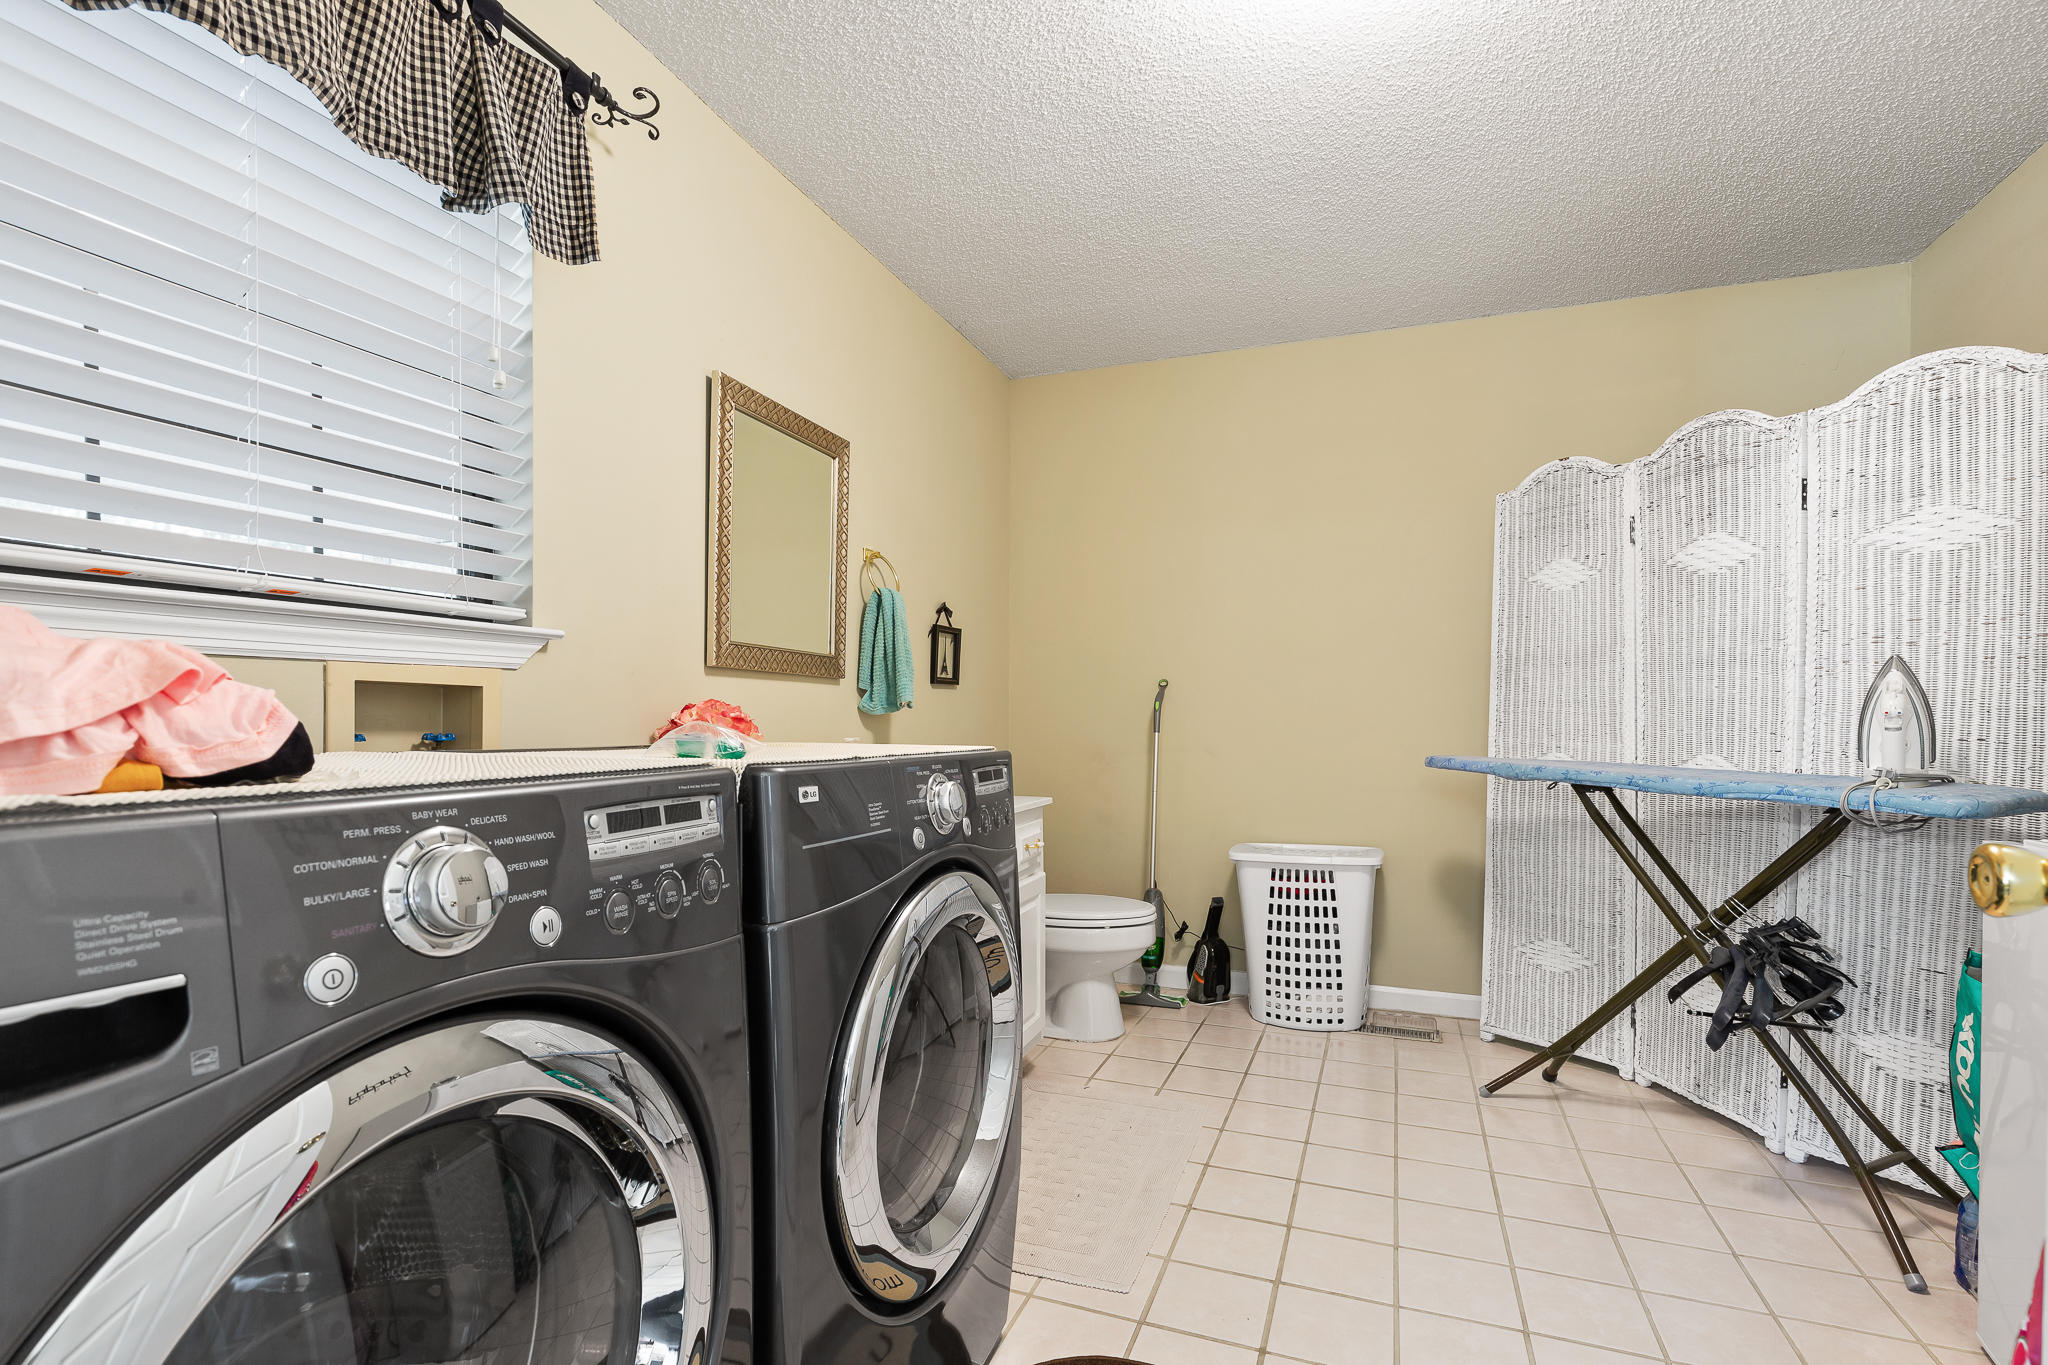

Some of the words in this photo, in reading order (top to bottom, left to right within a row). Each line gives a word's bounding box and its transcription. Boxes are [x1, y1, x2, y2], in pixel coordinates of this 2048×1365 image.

[411, 810, 434, 820] BABY
[434, 807, 459, 818] WEAR
[470, 814, 508, 826] DELICATES
[342, 828, 371, 839] PERM.
[373, 825, 402, 836] PRESS
[494, 837, 514, 847] HAND
[514, 831, 556, 844] WASH/WOOL
[292, 855, 379, 874] COTTON/NORMAL
[507, 862, 529, 872] SPEED
[529, 858, 549, 869] WASH
[303, 888, 371, 907] BULKY/LARGE
[508, 889, 547, 903] DRAIN+SPIN
[102, 911, 150, 924] Capacity
[74, 927, 107, 939] Direct
[108, 924, 138, 934] Drive
[139, 917, 178, 929] System
[331, 922, 378, 939] SANITARY
[74, 936, 125, 951] Stainless
[126, 930, 154, 942] Steel
[154, 926, 184, 938] Drum
[75, 949, 106, 962] Quiet
[108, 941, 161, 956] Operation
